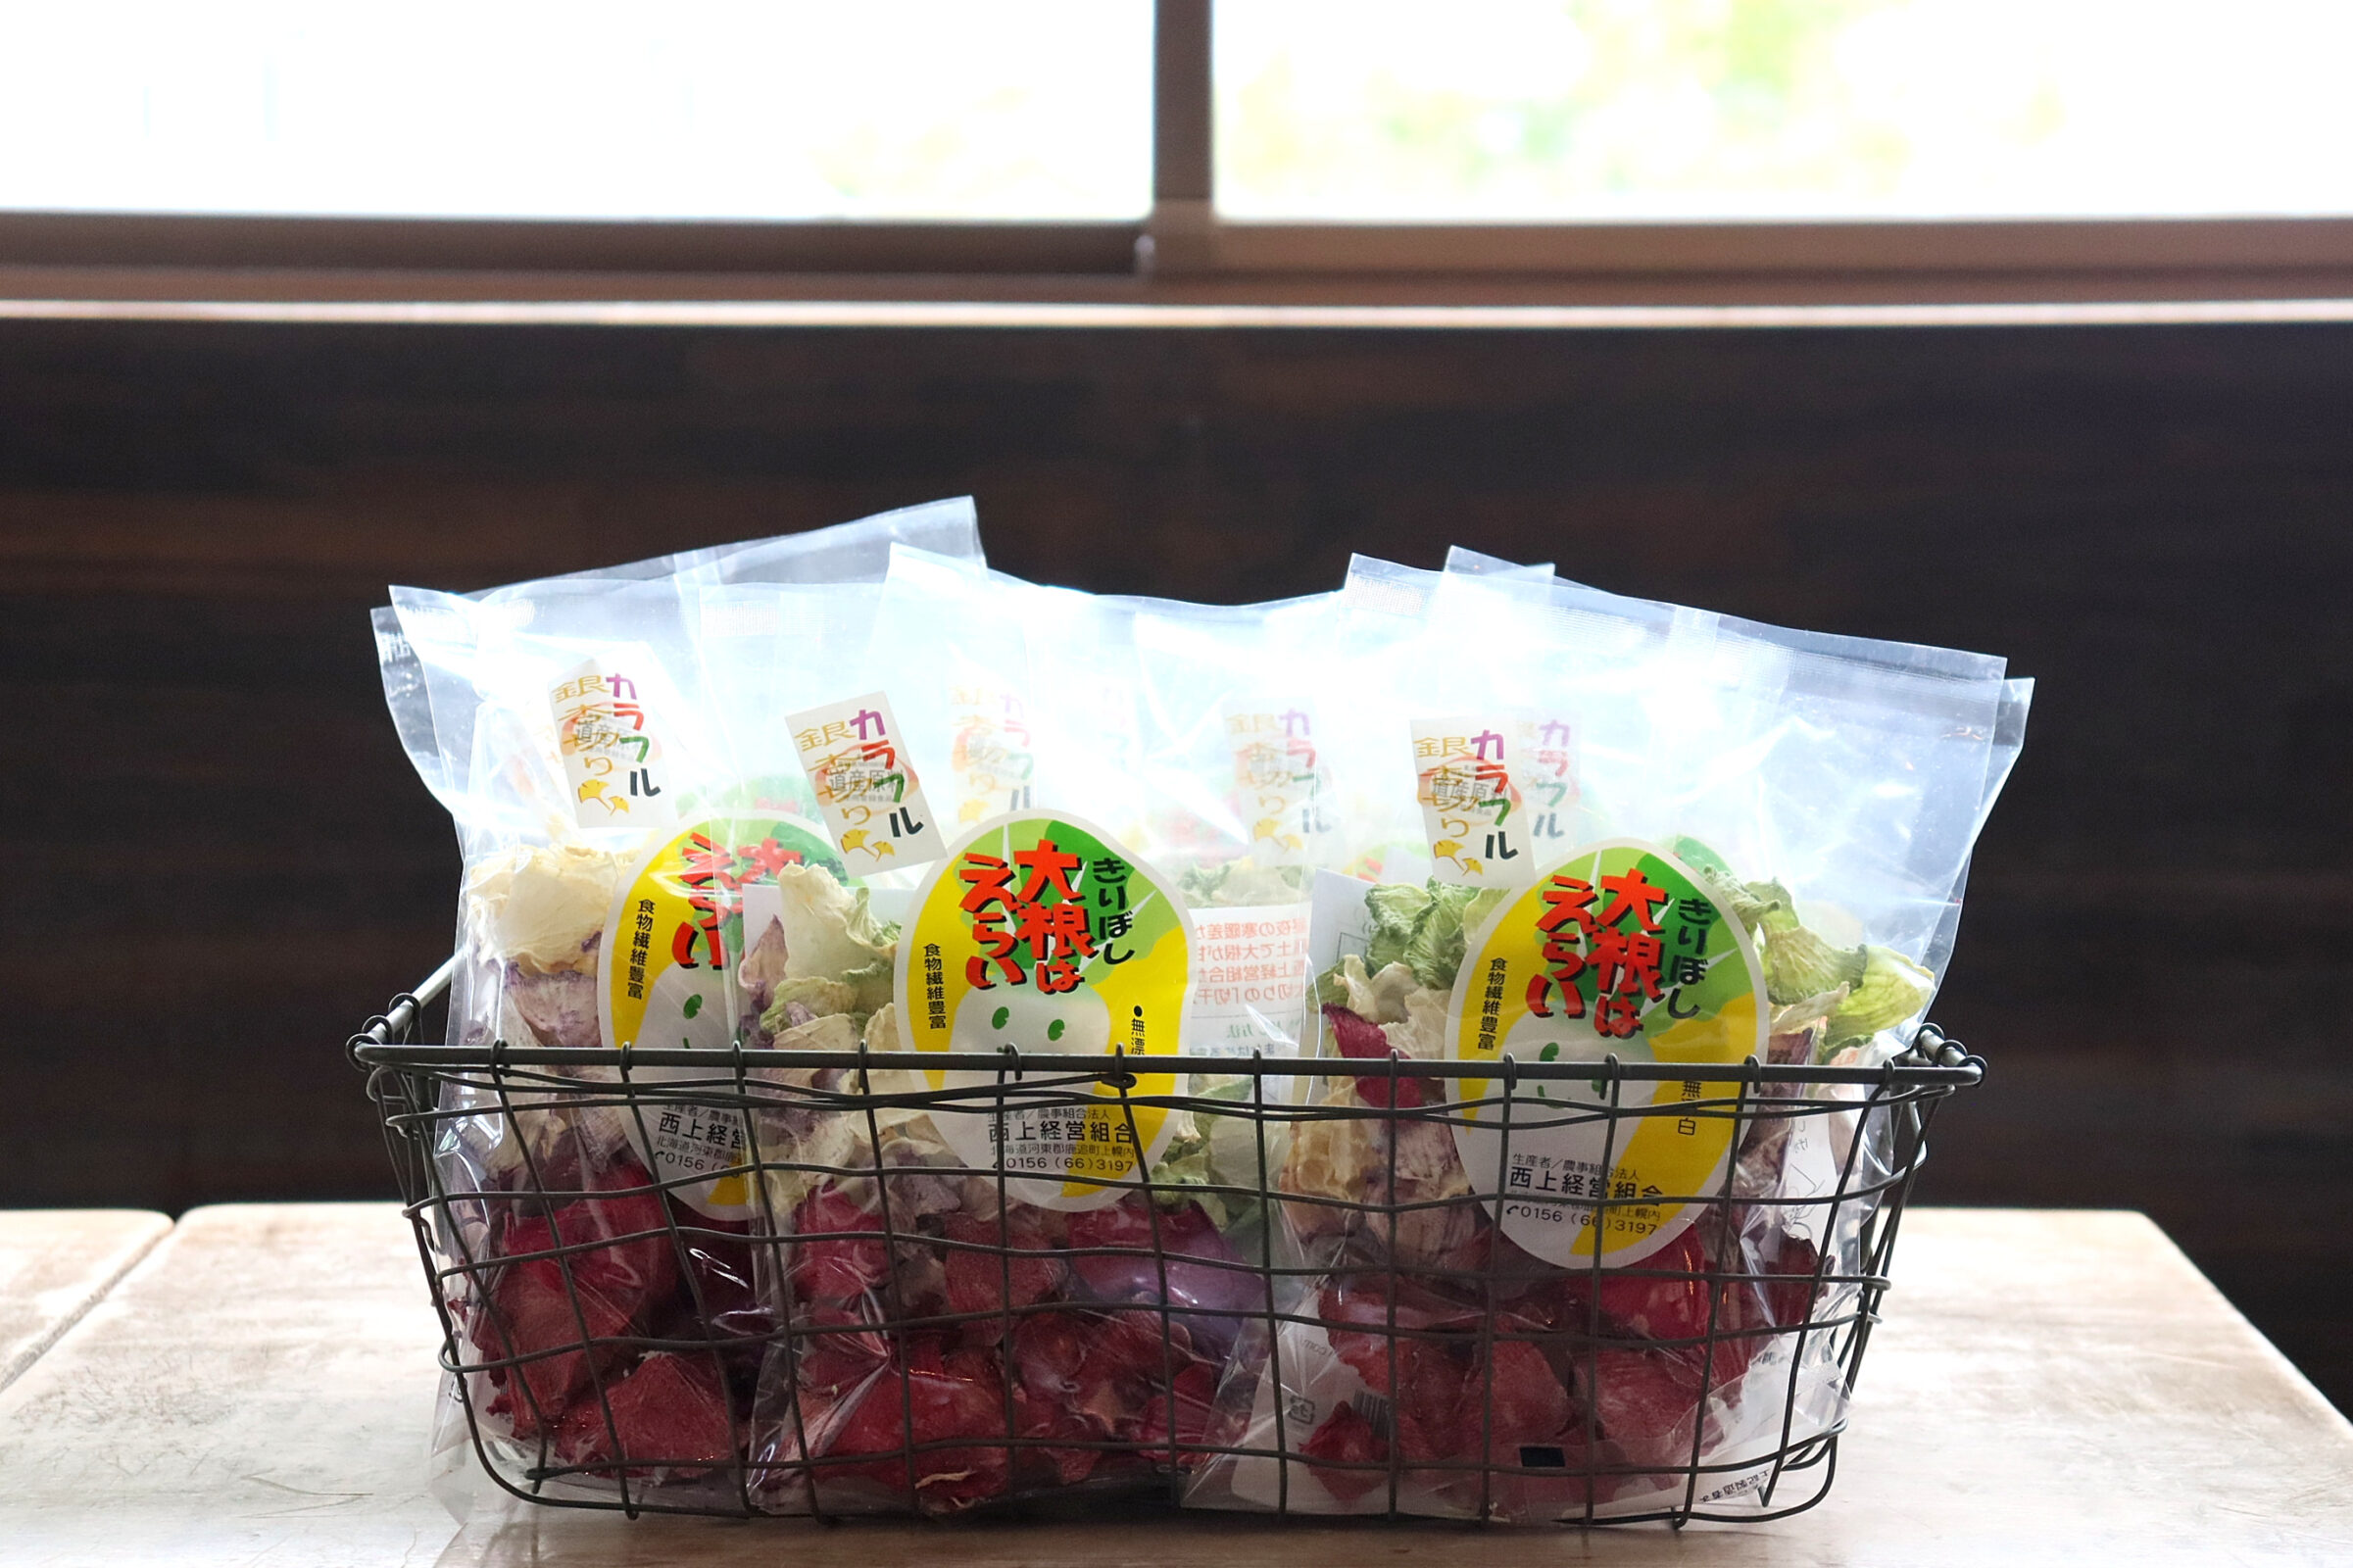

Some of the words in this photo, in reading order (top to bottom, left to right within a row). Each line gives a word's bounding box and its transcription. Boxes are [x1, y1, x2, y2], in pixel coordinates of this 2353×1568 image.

[606, 672, 662, 798] カラフル
[850, 709, 923, 838] カラフル
[1471, 729, 1518, 860] カラフル
[958, 852, 1027, 990] えらい
[1012, 839, 1099, 994] 大根は
[1093, 857, 1135, 965] きりぼし
[1525, 874, 1599, 1019] えらい
[1584, 867, 1669, 1040] 大根は
[1667, 898, 1713, 1020] きりぼし
[922, 942, 947, 1029] 食物繊維豊富
[1478, 956, 1508, 1052] 食物繊維豊富
[1678, 1080, 1702, 1136] 無白
